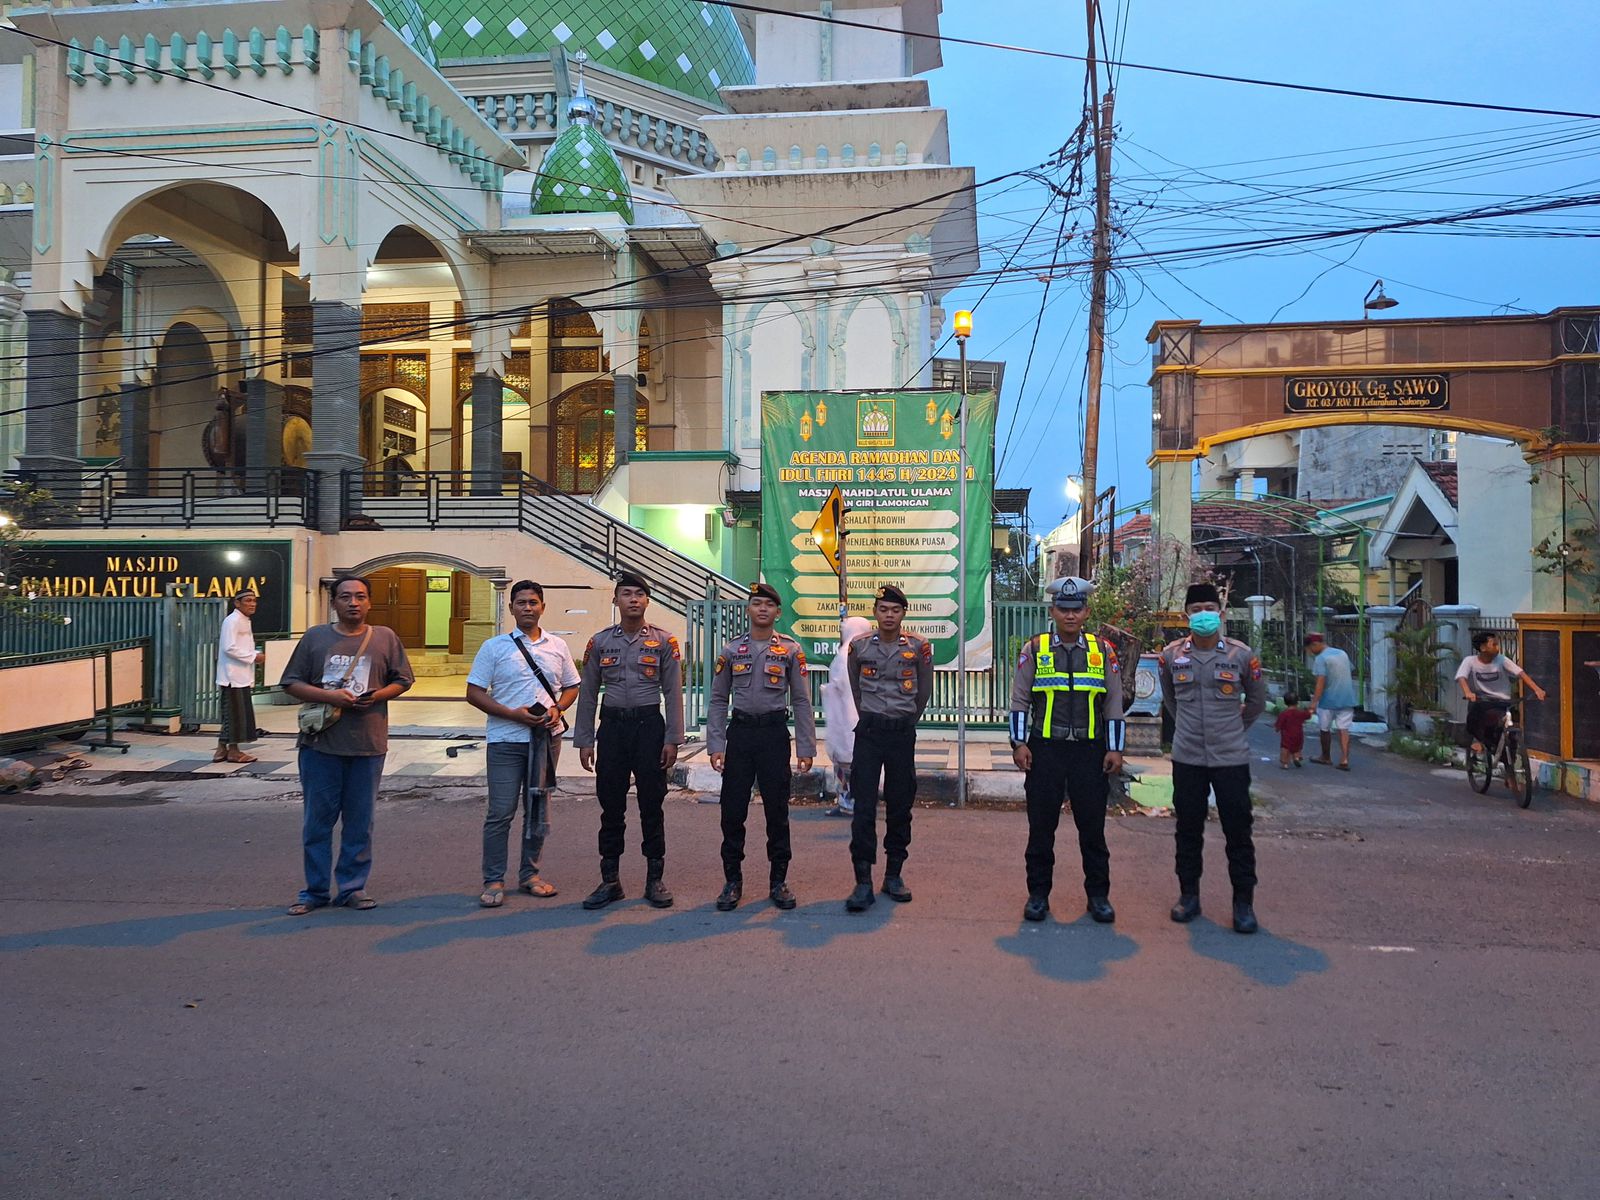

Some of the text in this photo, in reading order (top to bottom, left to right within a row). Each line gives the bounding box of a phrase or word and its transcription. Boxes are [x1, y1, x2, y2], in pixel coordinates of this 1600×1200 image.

[1294, 380, 1440, 398] GROYOK Gg. SAWO
[1306, 399, 1320, 408] RT.
[790, 449, 960, 465] AGENDA RAMADHAN DAN
[778, 468, 814, 482] IDUL
[816, 467, 853, 482] FITRI
[856, 466, 896, 482] 1445
[900, 466, 958, 484] H/2024
[798, 488, 953, 497] MASJI NAHDLATUL ULAMA'
[845, 516, 906, 524] SHALAT TAROWIH
[886, 538, 920, 546] BERBUKA
[922, 537, 946, 546] PUASA
[106, 556, 179, 572] MASJID
[846, 559, 911, 567] DARUS AL-QUR'AN
[21, 576, 266, 598] NAHDLATUL ULAMA'
[817, 603, 838, 611] ZAKAT
[847, 603, 865, 611] TRAH
[906, 603, 932, 611] ELILING
[801, 624, 840, 632] SHOLAT IDU
